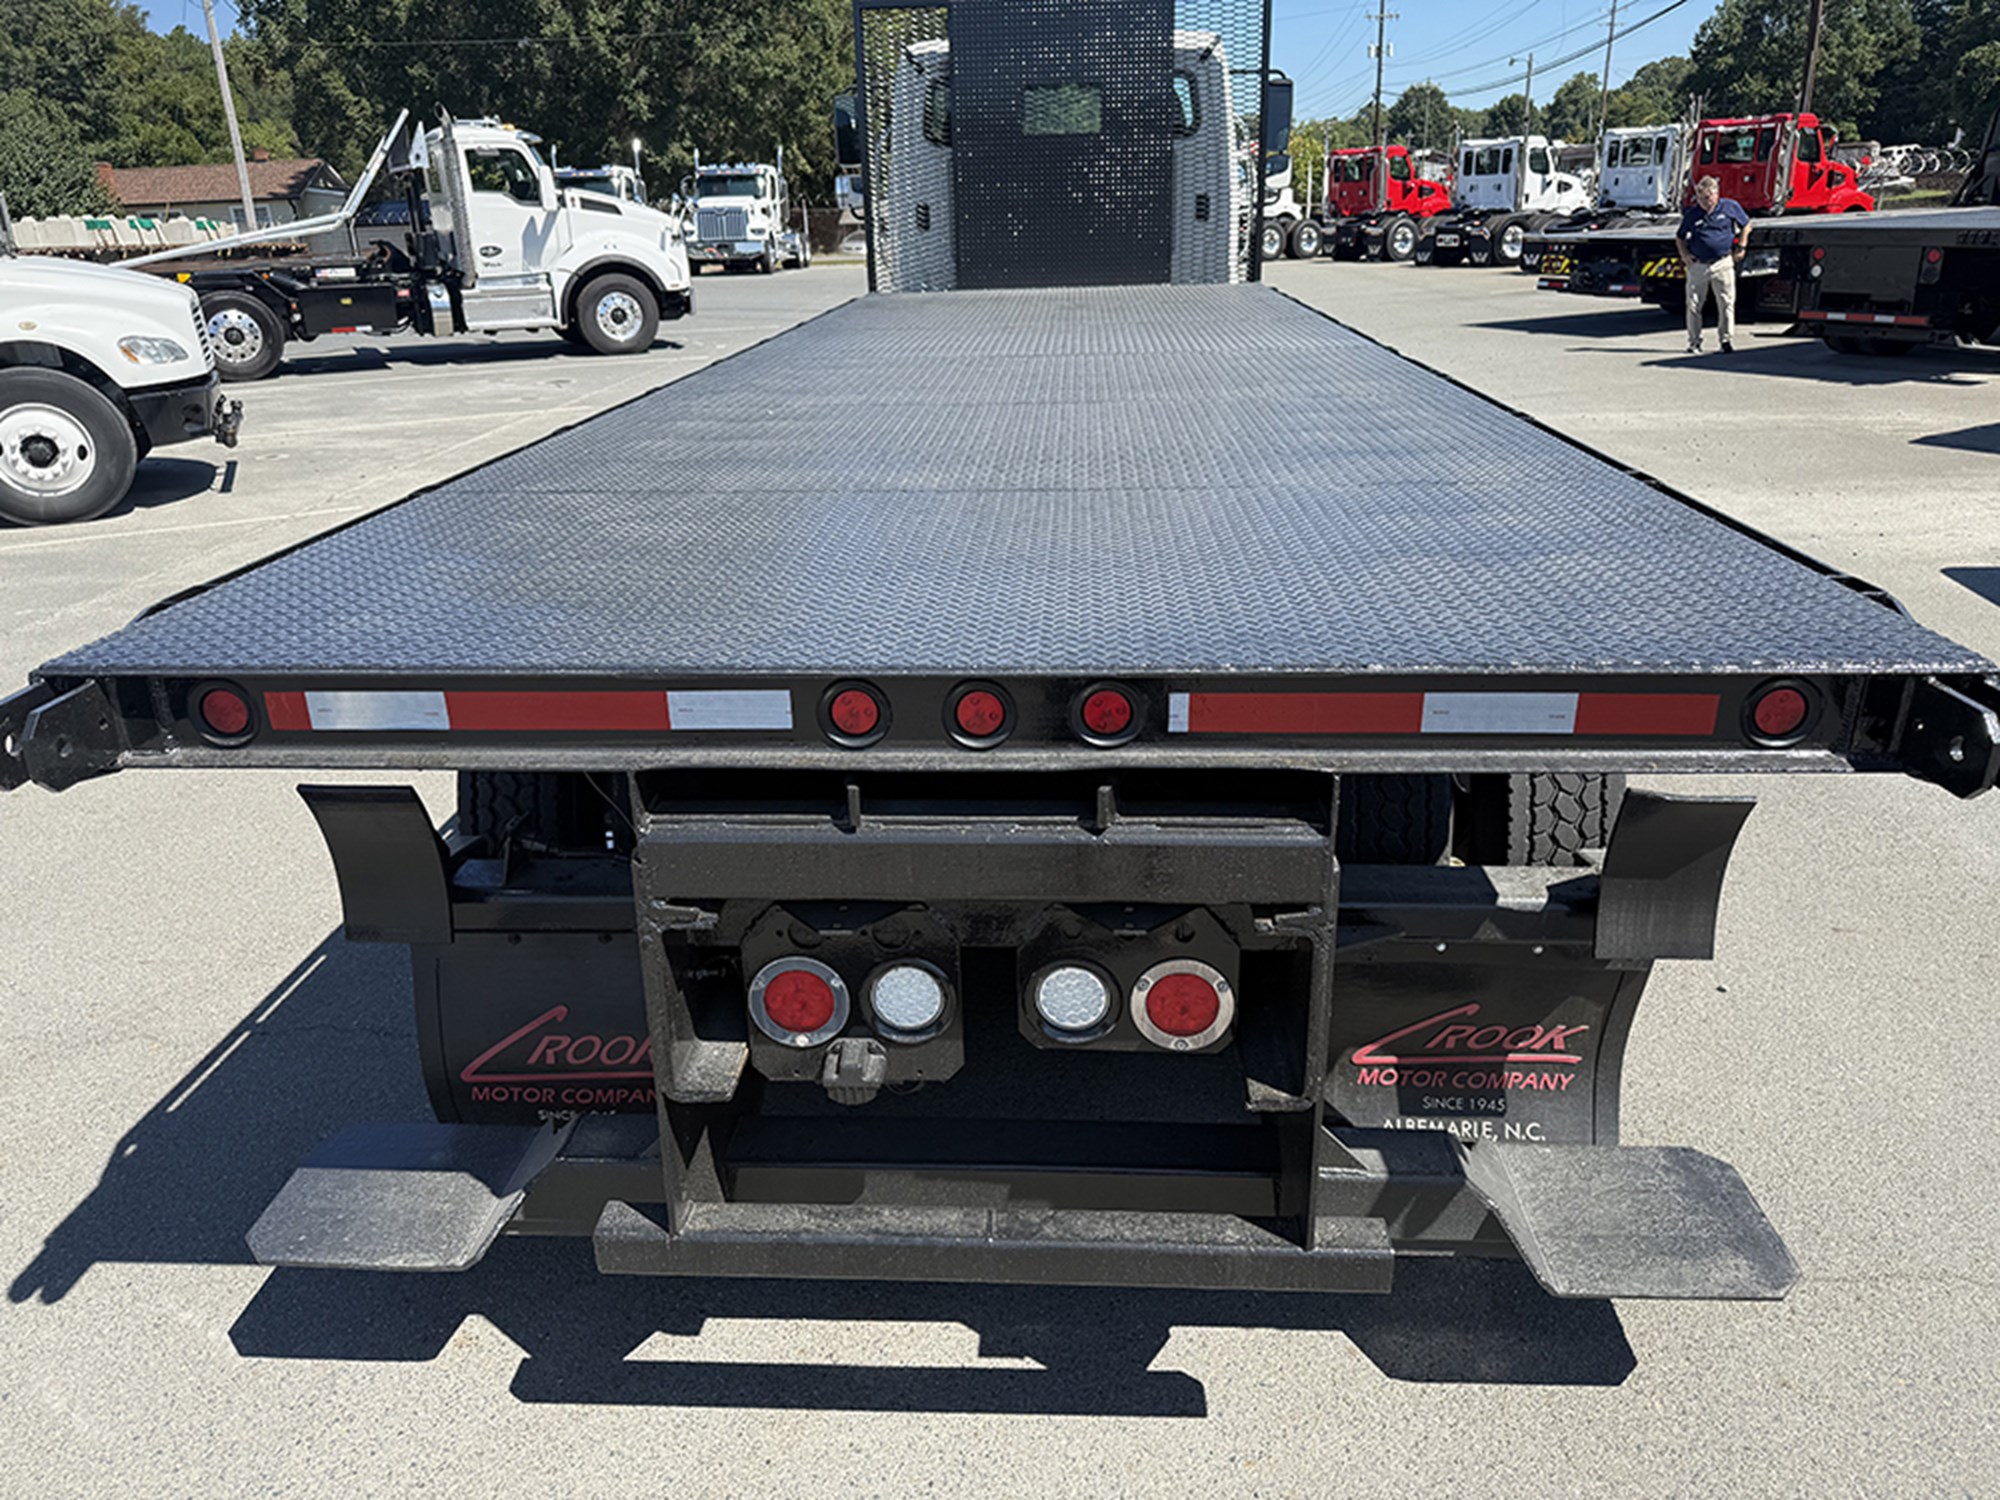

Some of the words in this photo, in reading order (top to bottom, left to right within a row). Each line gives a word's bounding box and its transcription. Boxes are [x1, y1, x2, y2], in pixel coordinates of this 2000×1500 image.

[1352, 1003, 1590, 1064] CROOK
[1356, 1067, 1446, 1088] MOTOR
[1452, 1071, 1575, 1091] COMPANY
[471, 1086, 555, 1103] MOTOR
[561, 1087, 657, 1104] COMPAN
[1422, 1096, 1464, 1111] SINCE
[1470, 1098, 1506, 1112] 1945
[1505, 1121, 1547, 1141] N.C.
